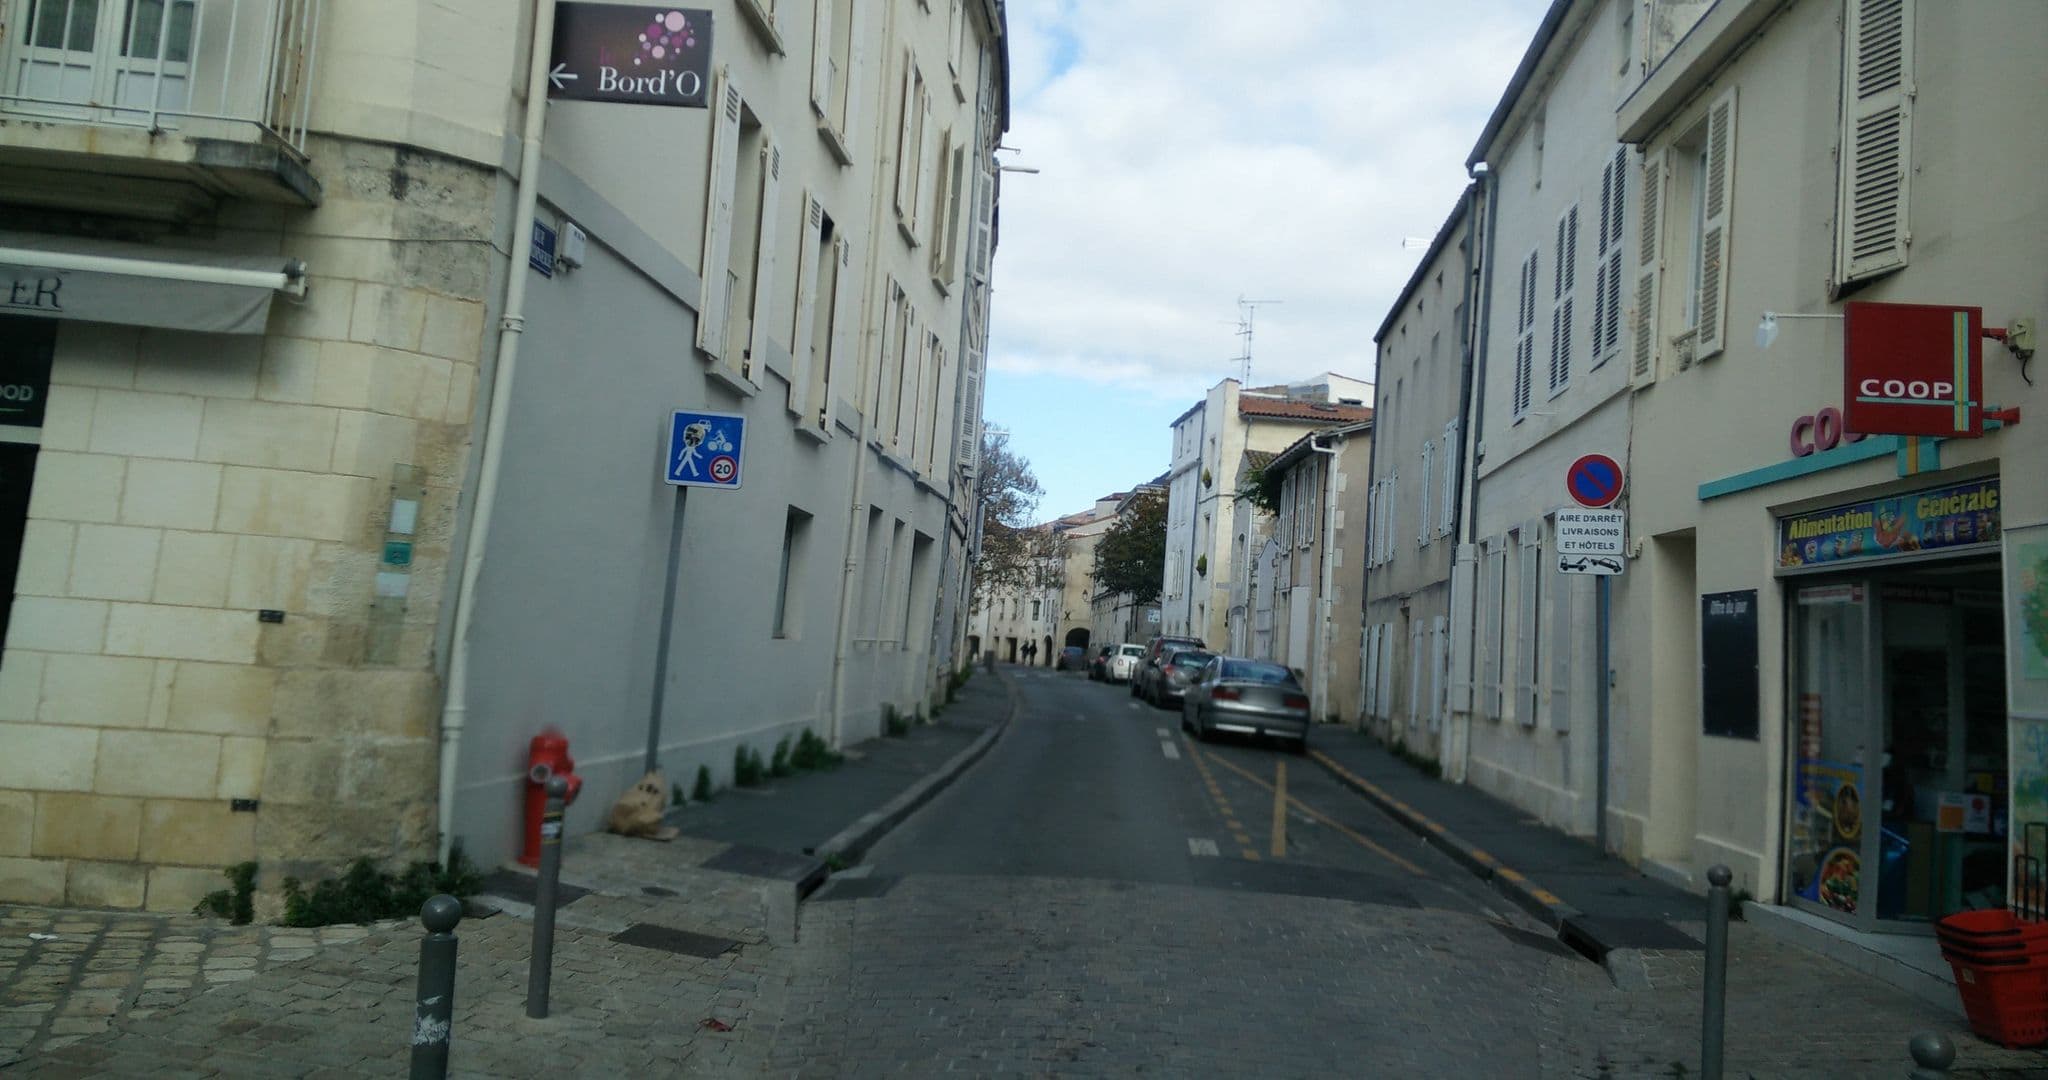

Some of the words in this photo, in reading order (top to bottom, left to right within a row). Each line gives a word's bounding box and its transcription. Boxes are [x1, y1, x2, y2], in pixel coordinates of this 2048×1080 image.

[597, 66, 700, 96] Bord'O
[0, 384, 34, 401] OD
[1860, 378, 1953, 399] COOP
[715, 464, 731, 475] 20
[1559, 514, 1581, 522] AIRE
[1583, 513, 1622, 523] D'ARRÊT
[1788, 508, 1873, 540] Alimentation
[1916, 486, 1998, 520] Générale
[1562, 528, 1619, 536] LIVRAISONS
[1565, 541, 1576, 549] ET
[1578, 540, 1615, 550] HÔTELS
